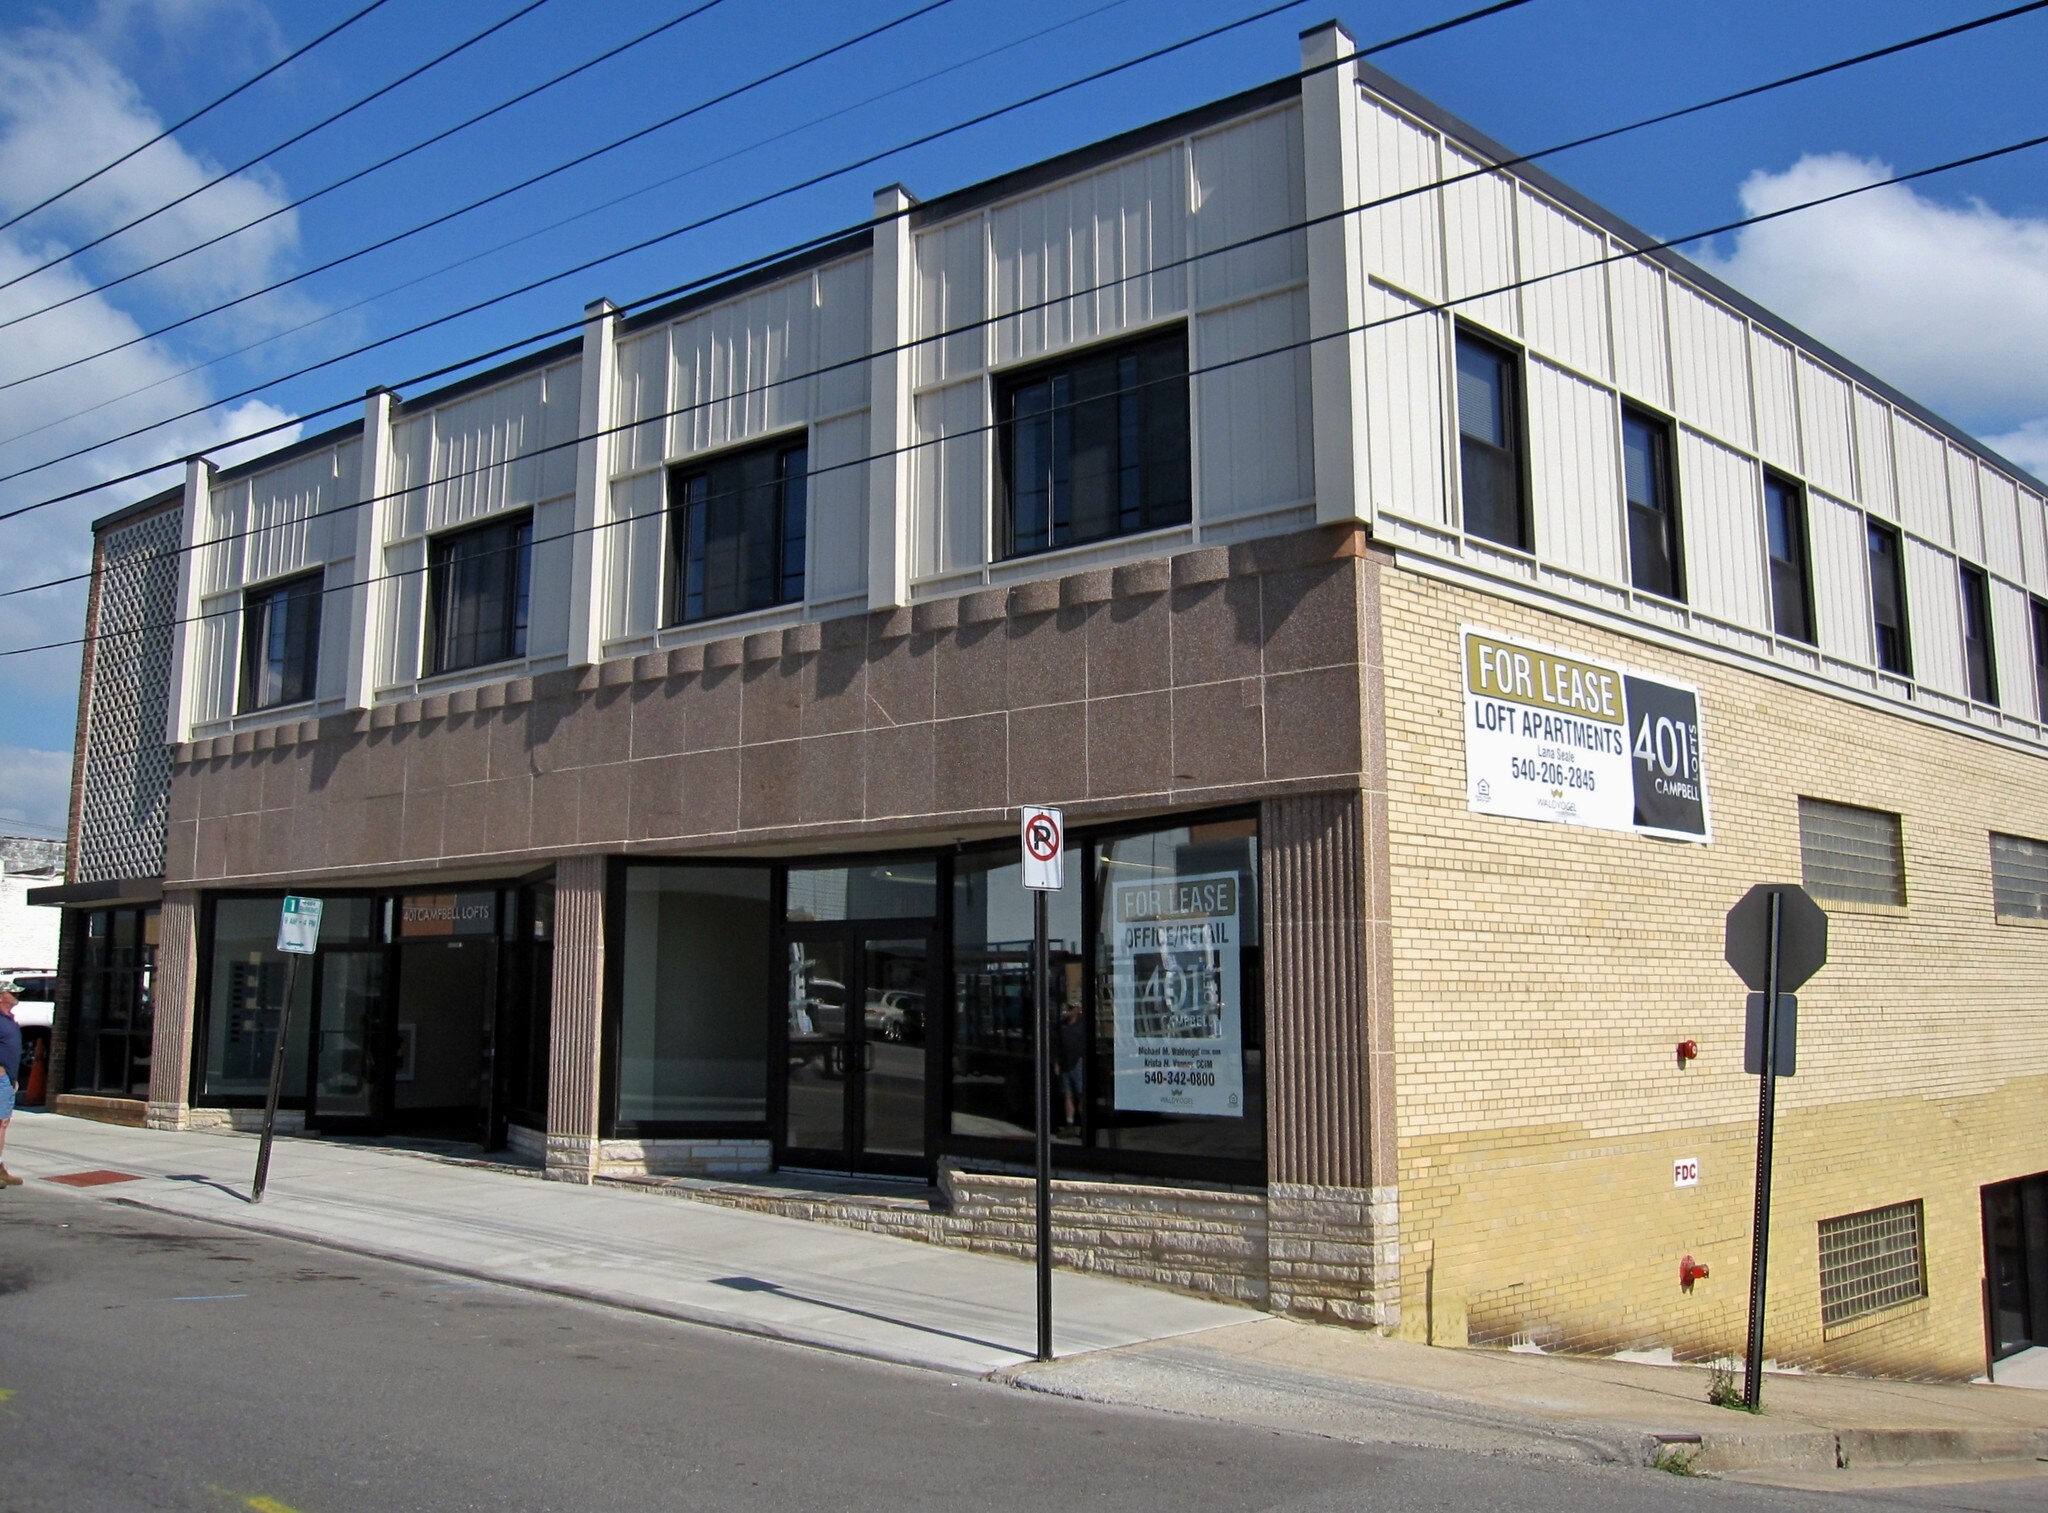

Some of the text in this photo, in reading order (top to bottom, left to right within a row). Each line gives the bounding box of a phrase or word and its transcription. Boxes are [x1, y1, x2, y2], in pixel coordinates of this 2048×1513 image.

[1478, 643, 1617, 717] FOR LEASE
[1475, 701, 1624, 756] LOFT APARTMENTS
[1538, 744, 1575, 763] Lana Seale
[1633, 712, 1689, 779] 401
[1689, 724, 1699, 782] LOFTS
[1512, 757, 1595, 791] 540-206-2845
[1655, 778, 1700, 802] CAMPBELL
[1537, 797, 1577, 812] WALDVOGEL
[290, 899, 296, 912] 1
[1124, 883, 1228, 918] FOR LEASE
[417, 907, 460, 921] CAMPBELL
[462, 905, 489, 919] LOFTS
[1125, 923, 1229, 949] OFFICE/RETAIL
[1142, 965, 1200, 1012] 401
[1138, 1047, 1161, 1056] Michael
[1144, 1059, 1162, 1067] Krista
[1144, 1071, 1215, 1087] 540-342-0800
[1675, 1163, 1696, 1182] FDC
